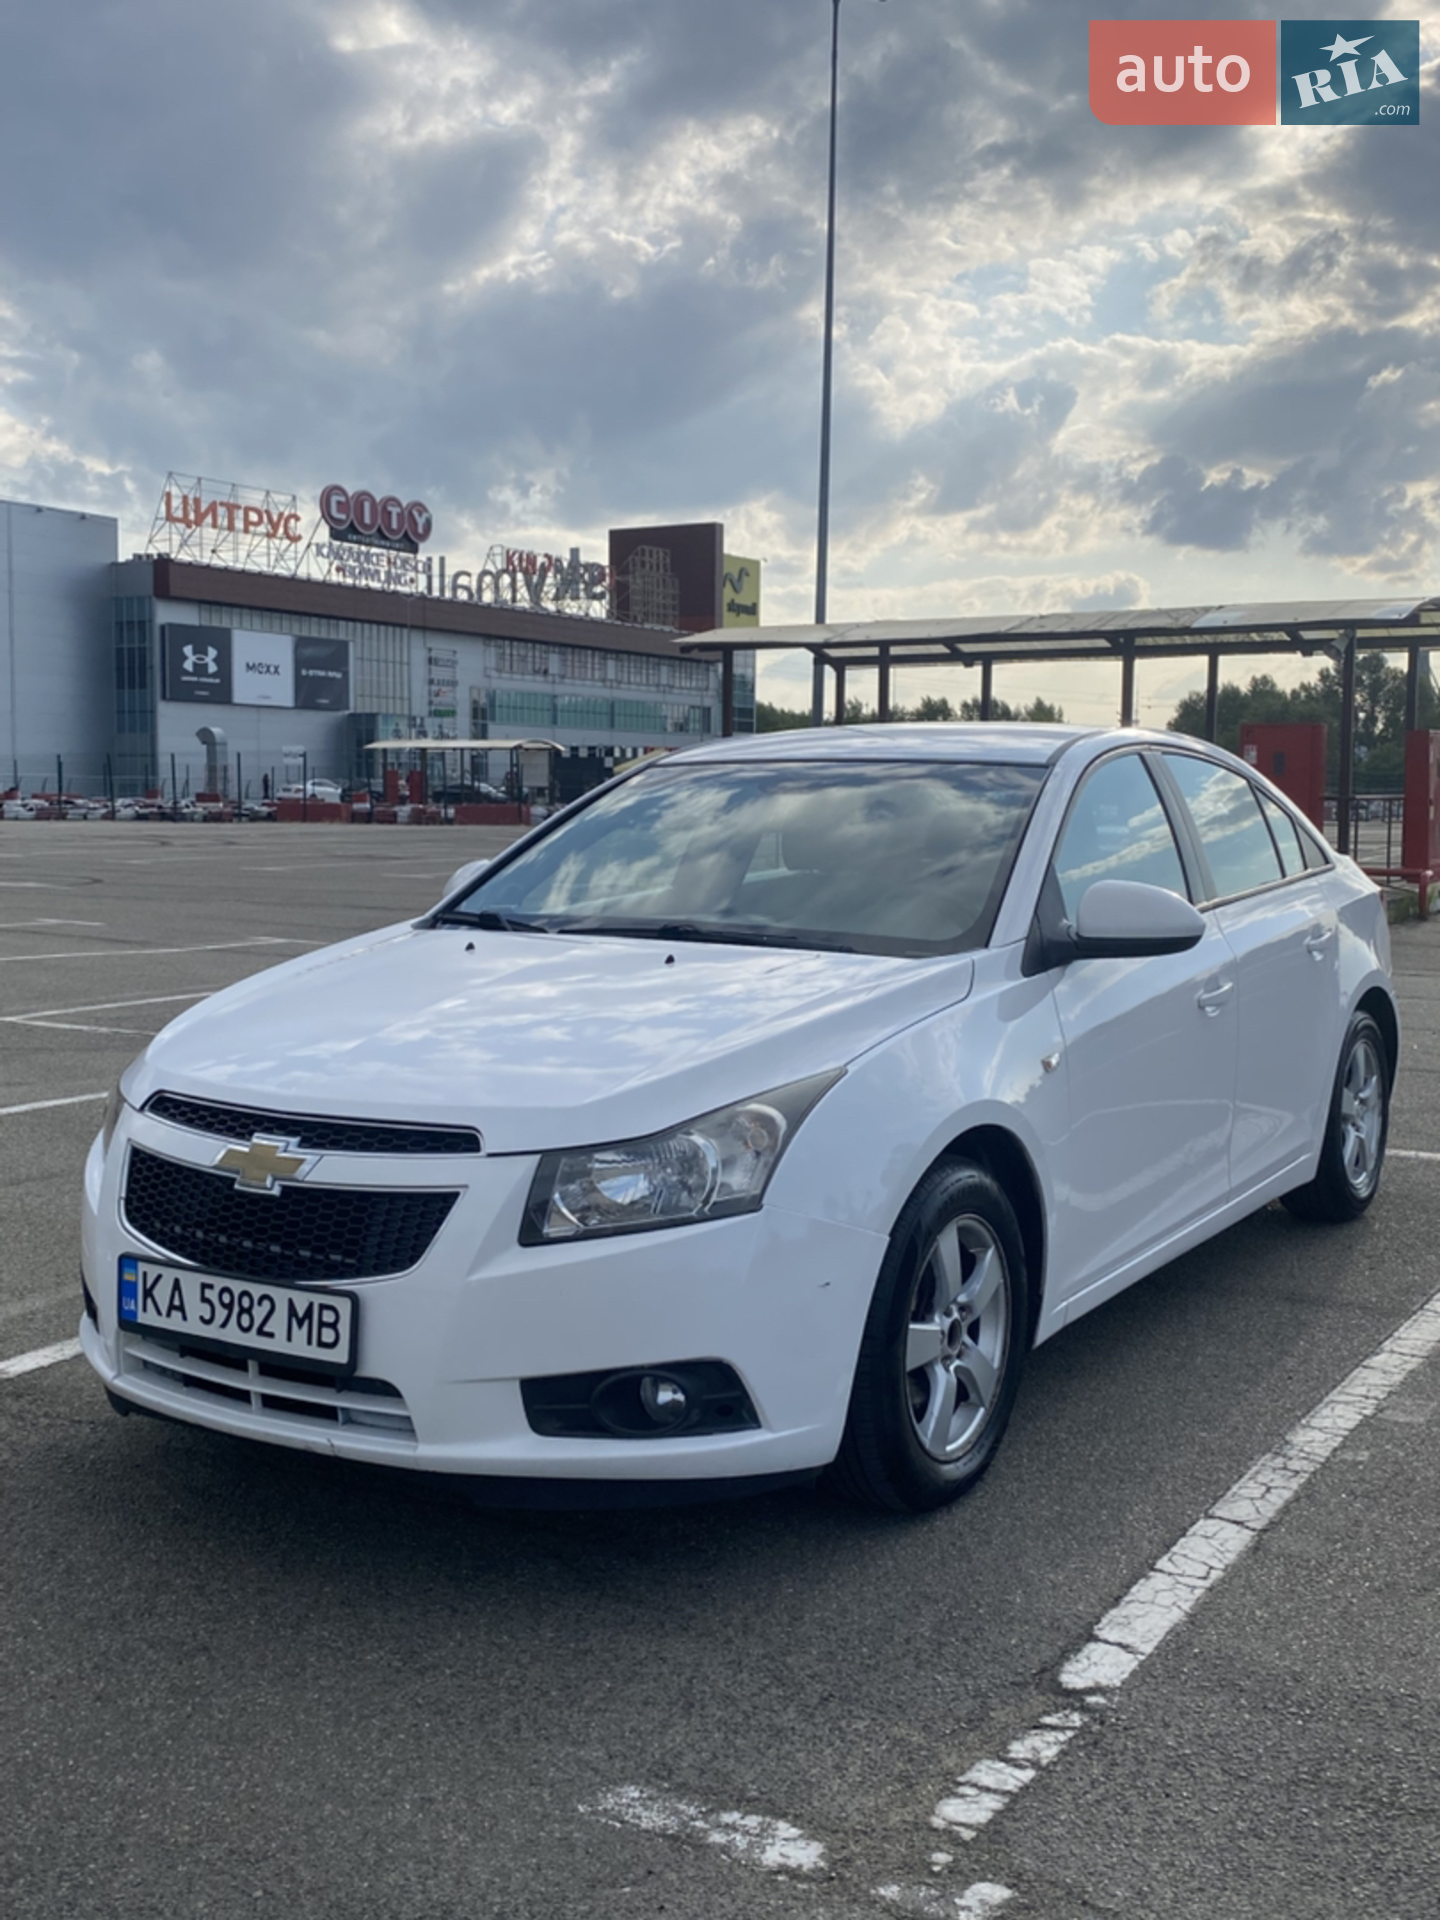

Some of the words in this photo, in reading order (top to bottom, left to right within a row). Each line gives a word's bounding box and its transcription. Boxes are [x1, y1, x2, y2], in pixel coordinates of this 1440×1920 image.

[164, 491, 303, 543] ЦИТРУС
[329, 491, 430, 535] CITY
[122, 1296, 136, 1313] UA
[142, 1270, 188, 1322] KA
[199, 1281, 277, 1339] 5982
[286, 1296, 341, 1351] MB
